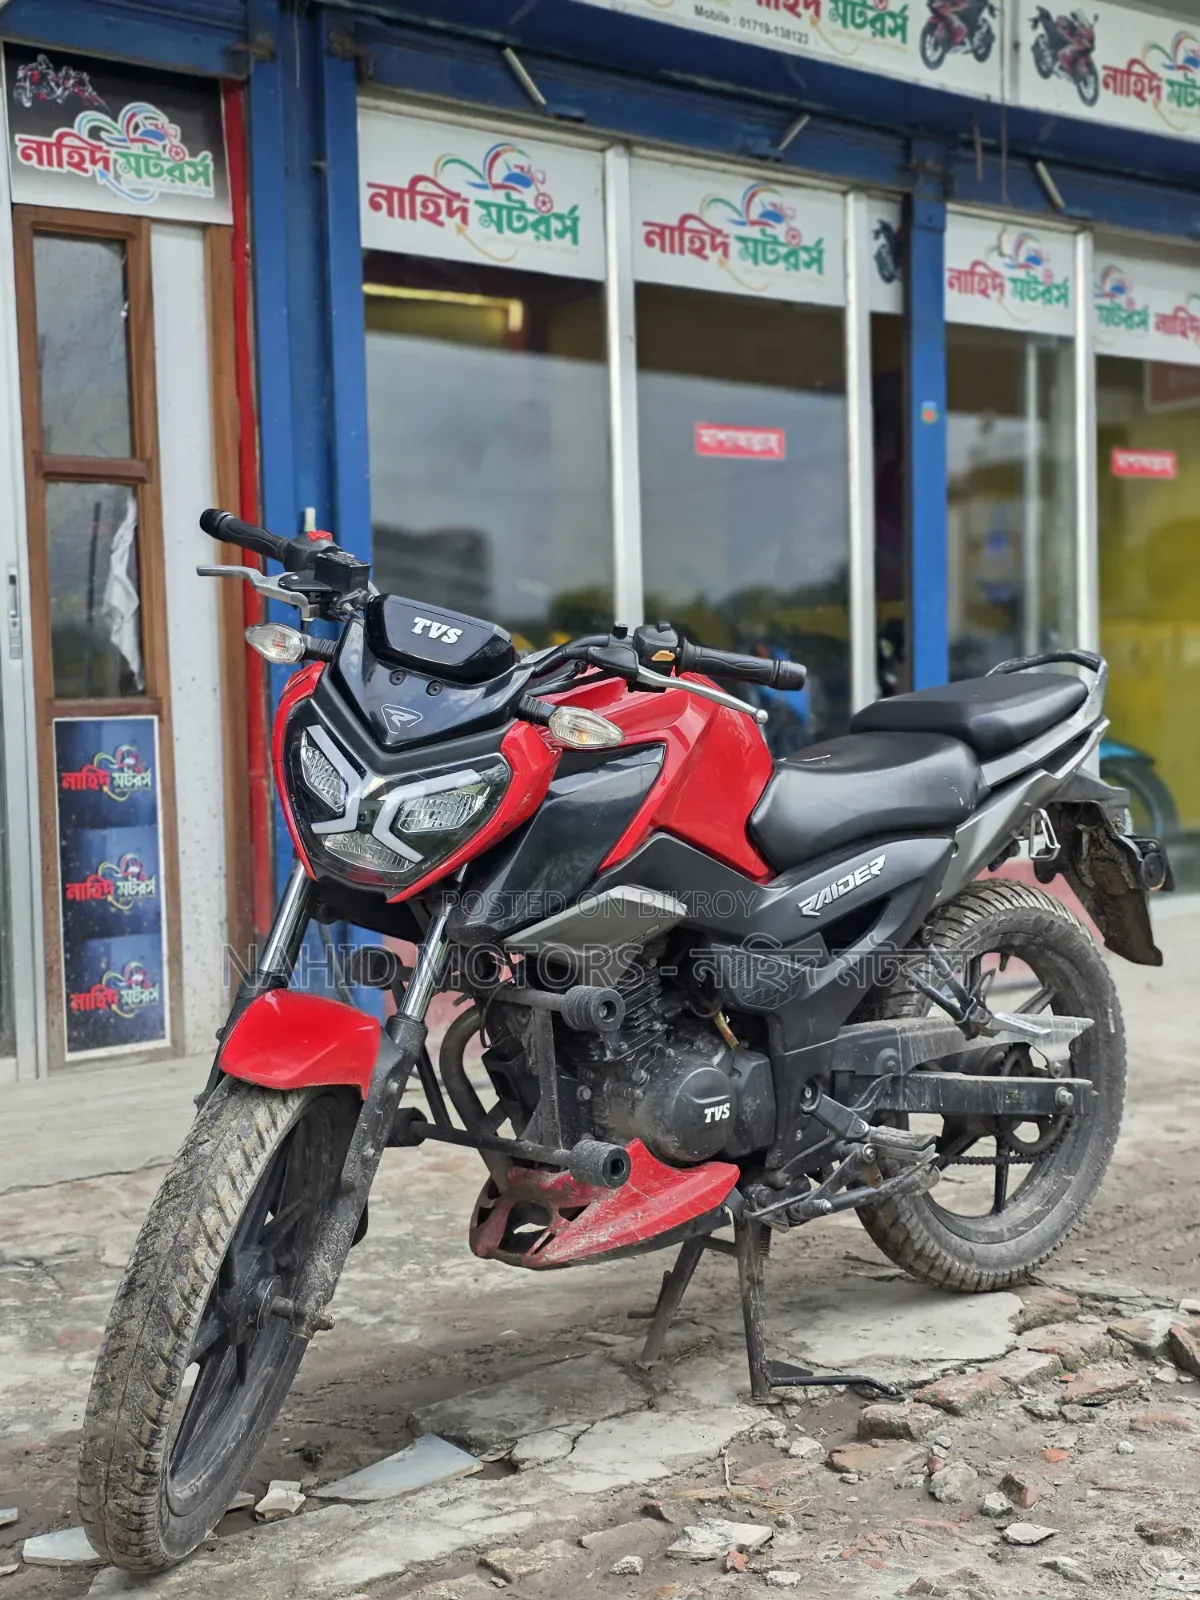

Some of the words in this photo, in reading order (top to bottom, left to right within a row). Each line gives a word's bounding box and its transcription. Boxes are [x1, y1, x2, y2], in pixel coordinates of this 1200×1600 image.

[693, 4, 731, 24] Mobile
[1102, 58, 1162, 103] নাহিদ
[18, 130, 111, 174] নাহিদ
[366, 174, 470, 228] নাহিদ
[642, 213, 731, 261] নাহিদ
[947, 259, 1005, 299] নাহিদ
[411, 616, 464, 644] TVS
[797, 853, 887, 918] RAIDER
[704, 1102, 731, 1123] TVS
